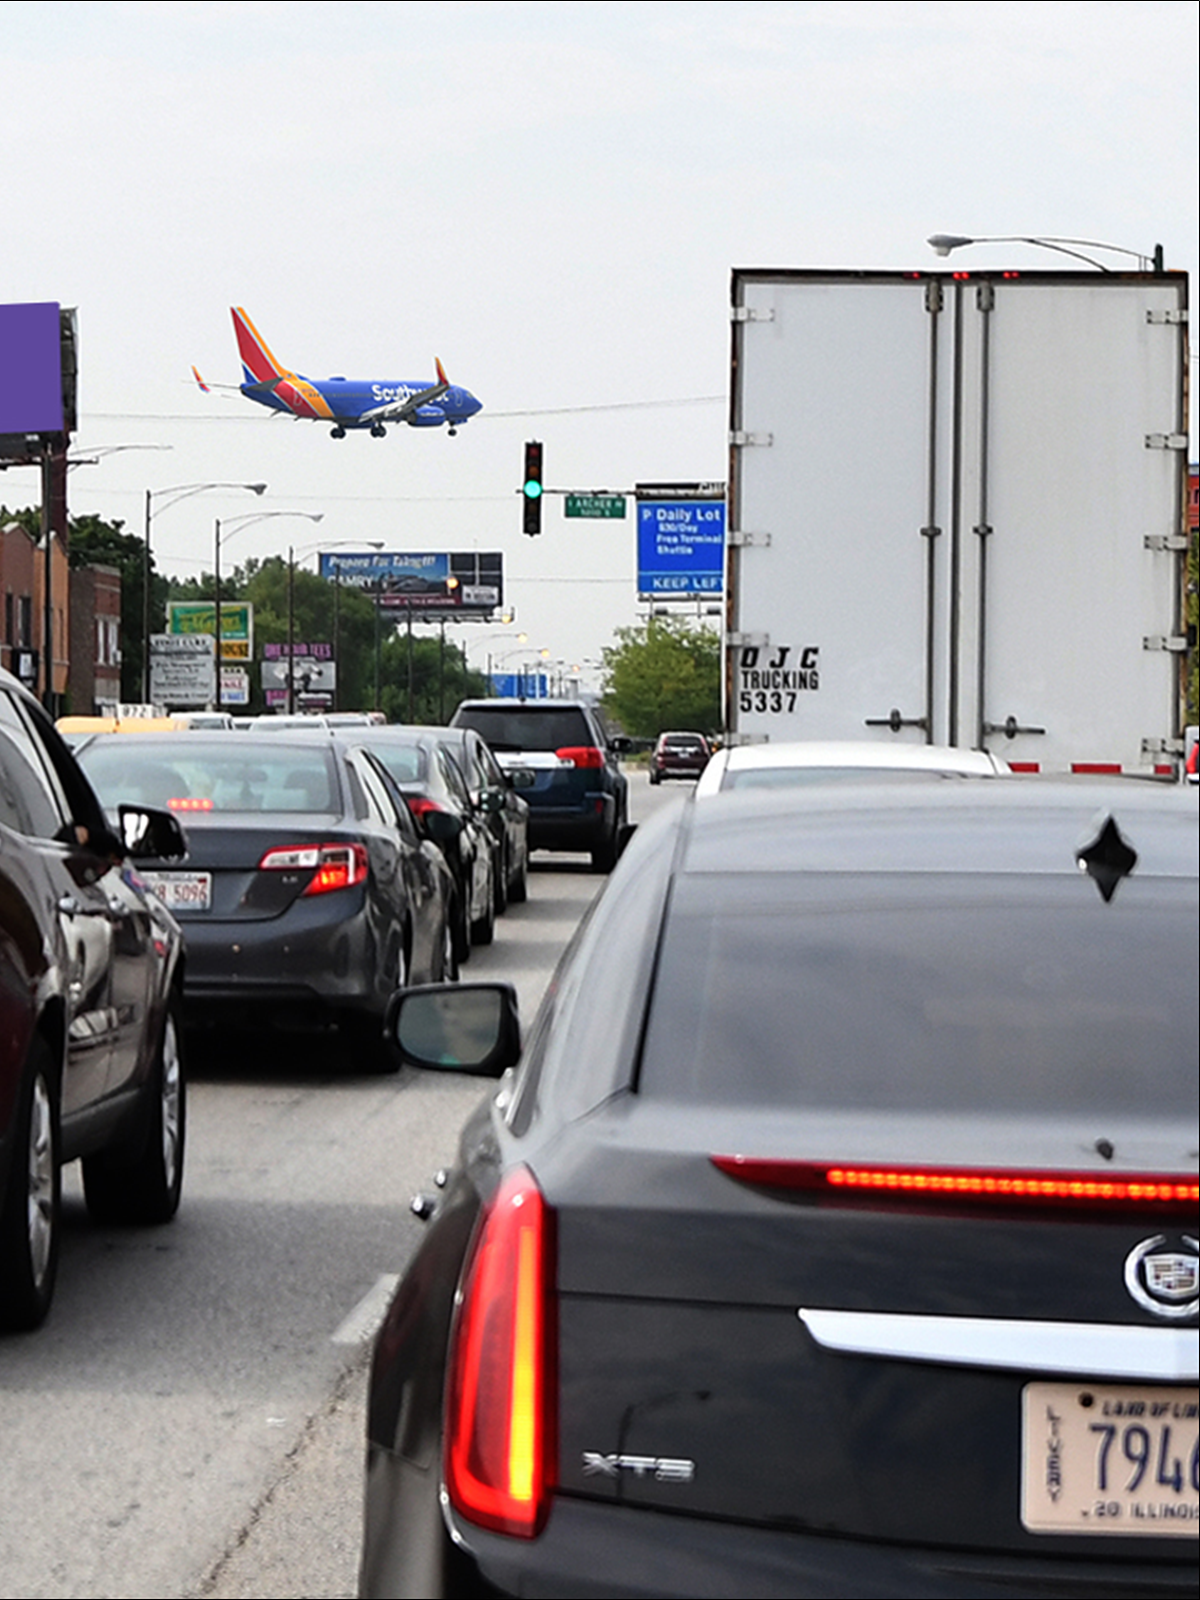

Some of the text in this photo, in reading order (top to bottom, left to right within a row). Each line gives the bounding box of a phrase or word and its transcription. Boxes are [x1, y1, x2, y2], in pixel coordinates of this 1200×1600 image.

[656, 508, 692, 522] Daily
[696, 508, 721, 521] Lot
[656, 534, 723, 544] Free Terminal
[652, 577, 688, 589] KEEP
[741, 670, 819, 690] TRUCKING
[740, 691, 797, 713] 5337
[1102, 1401, 1145, 1417] LAND
[1150, 1401, 1170, 1417] OF
[1046, 1404, 1062, 1503] LIVERY
[582, 1451, 696, 1483] XTS
